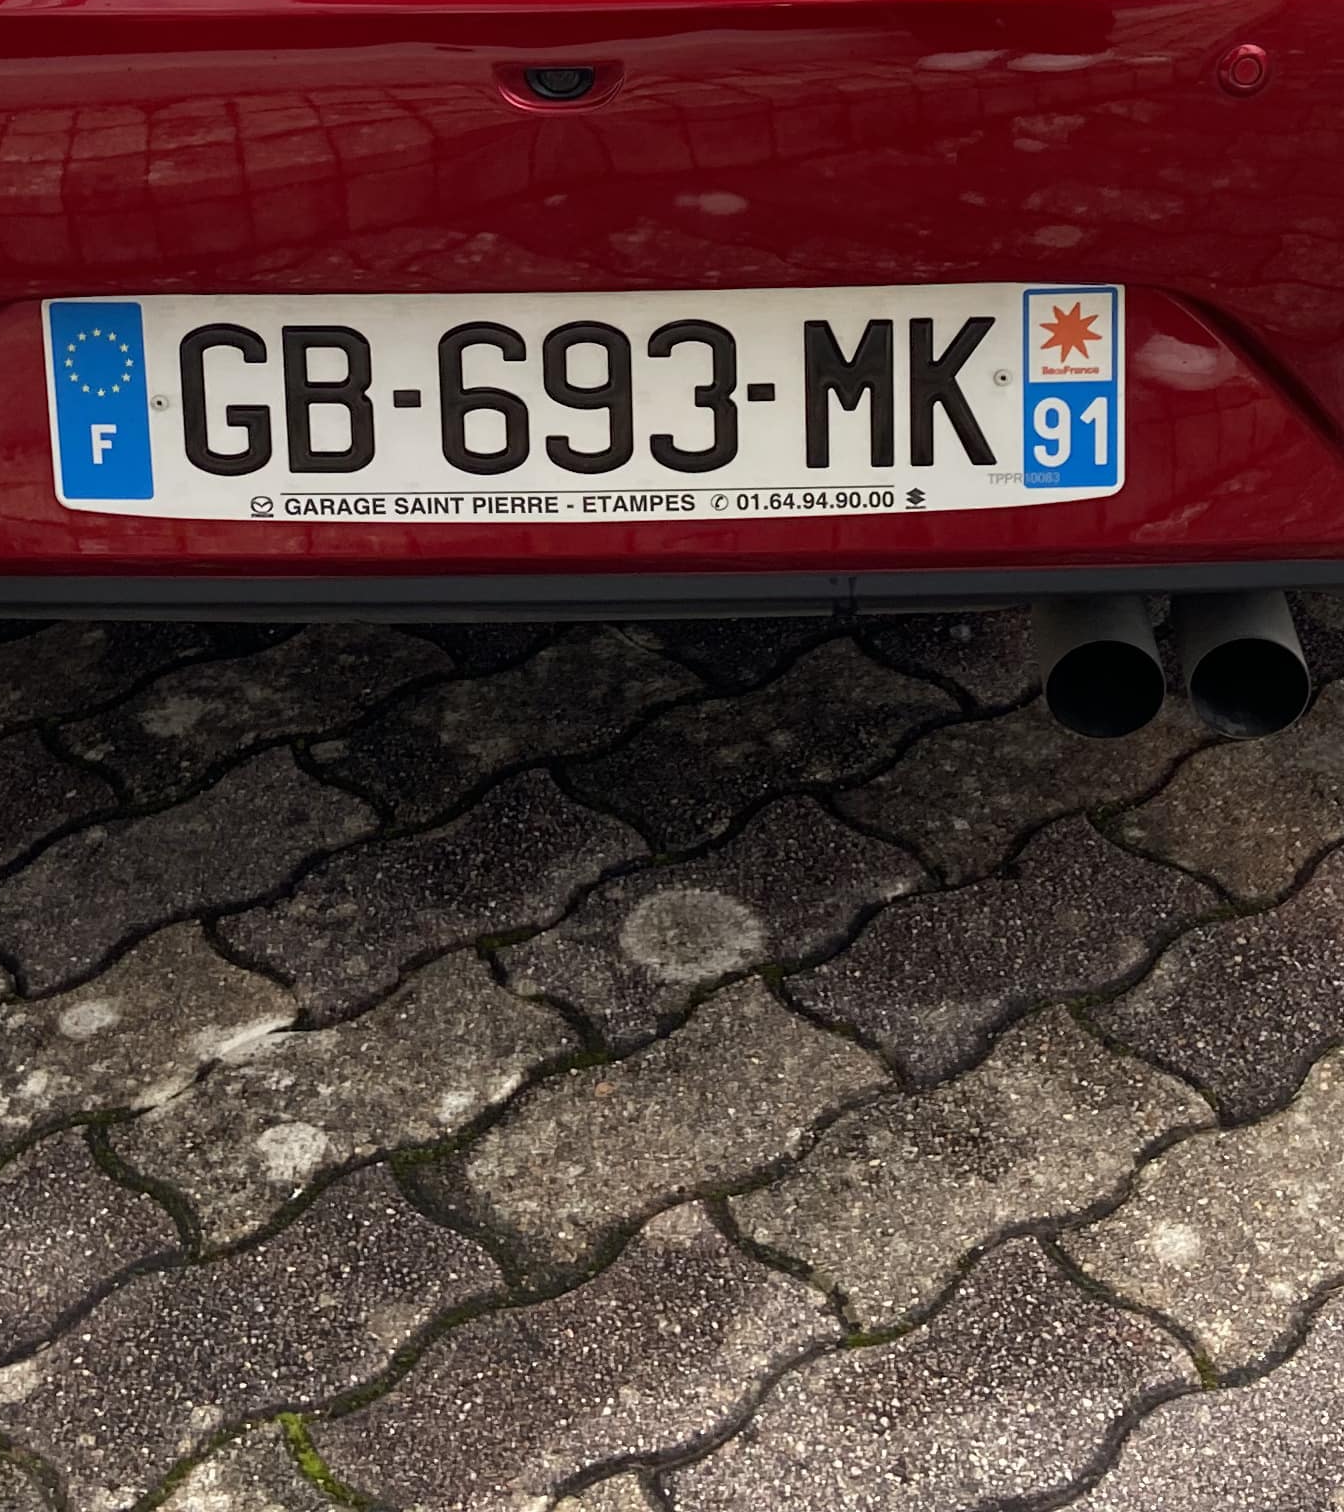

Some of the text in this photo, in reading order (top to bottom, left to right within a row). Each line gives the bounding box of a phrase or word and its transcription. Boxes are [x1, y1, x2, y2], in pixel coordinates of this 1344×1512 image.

[178, 318, 998, 477] GB-693-MK
[90, 423, 118, 465] F
[1033, 396, 1109, 468] 91
[284, 497, 387, 516] GARAGE
[394, 497, 465, 515] SAINT
[472, 496, 559, 514] PIERRE
[582, 494, 696, 513] ETAMPES
[736, 491, 895, 511] 01.64.94.90.00
